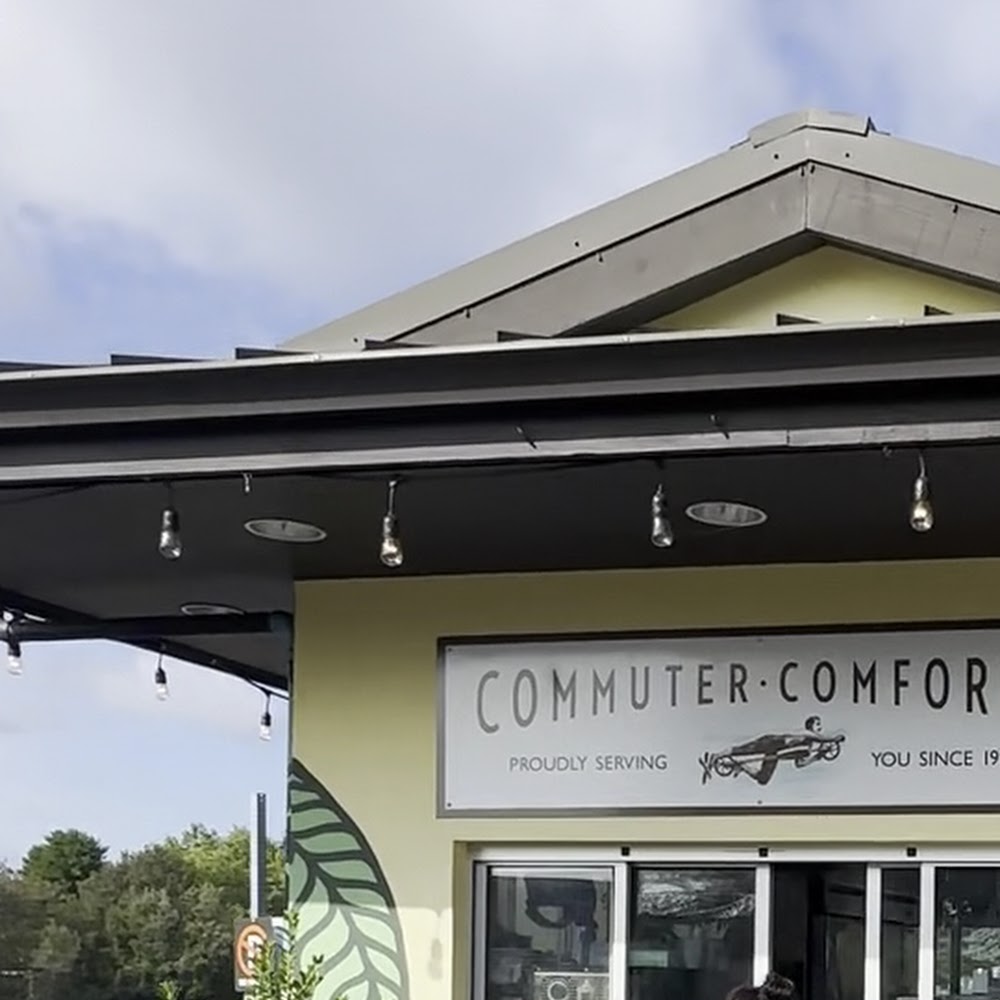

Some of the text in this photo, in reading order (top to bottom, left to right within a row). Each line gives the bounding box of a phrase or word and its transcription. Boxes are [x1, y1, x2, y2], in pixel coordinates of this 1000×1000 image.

[477, 663, 749, 733] COMMUTER
[510, 754, 668, 772] PROUDLY SERVING
[871, 751, 911, 767] YOU
[919, 751, 973, 767] SINCE
